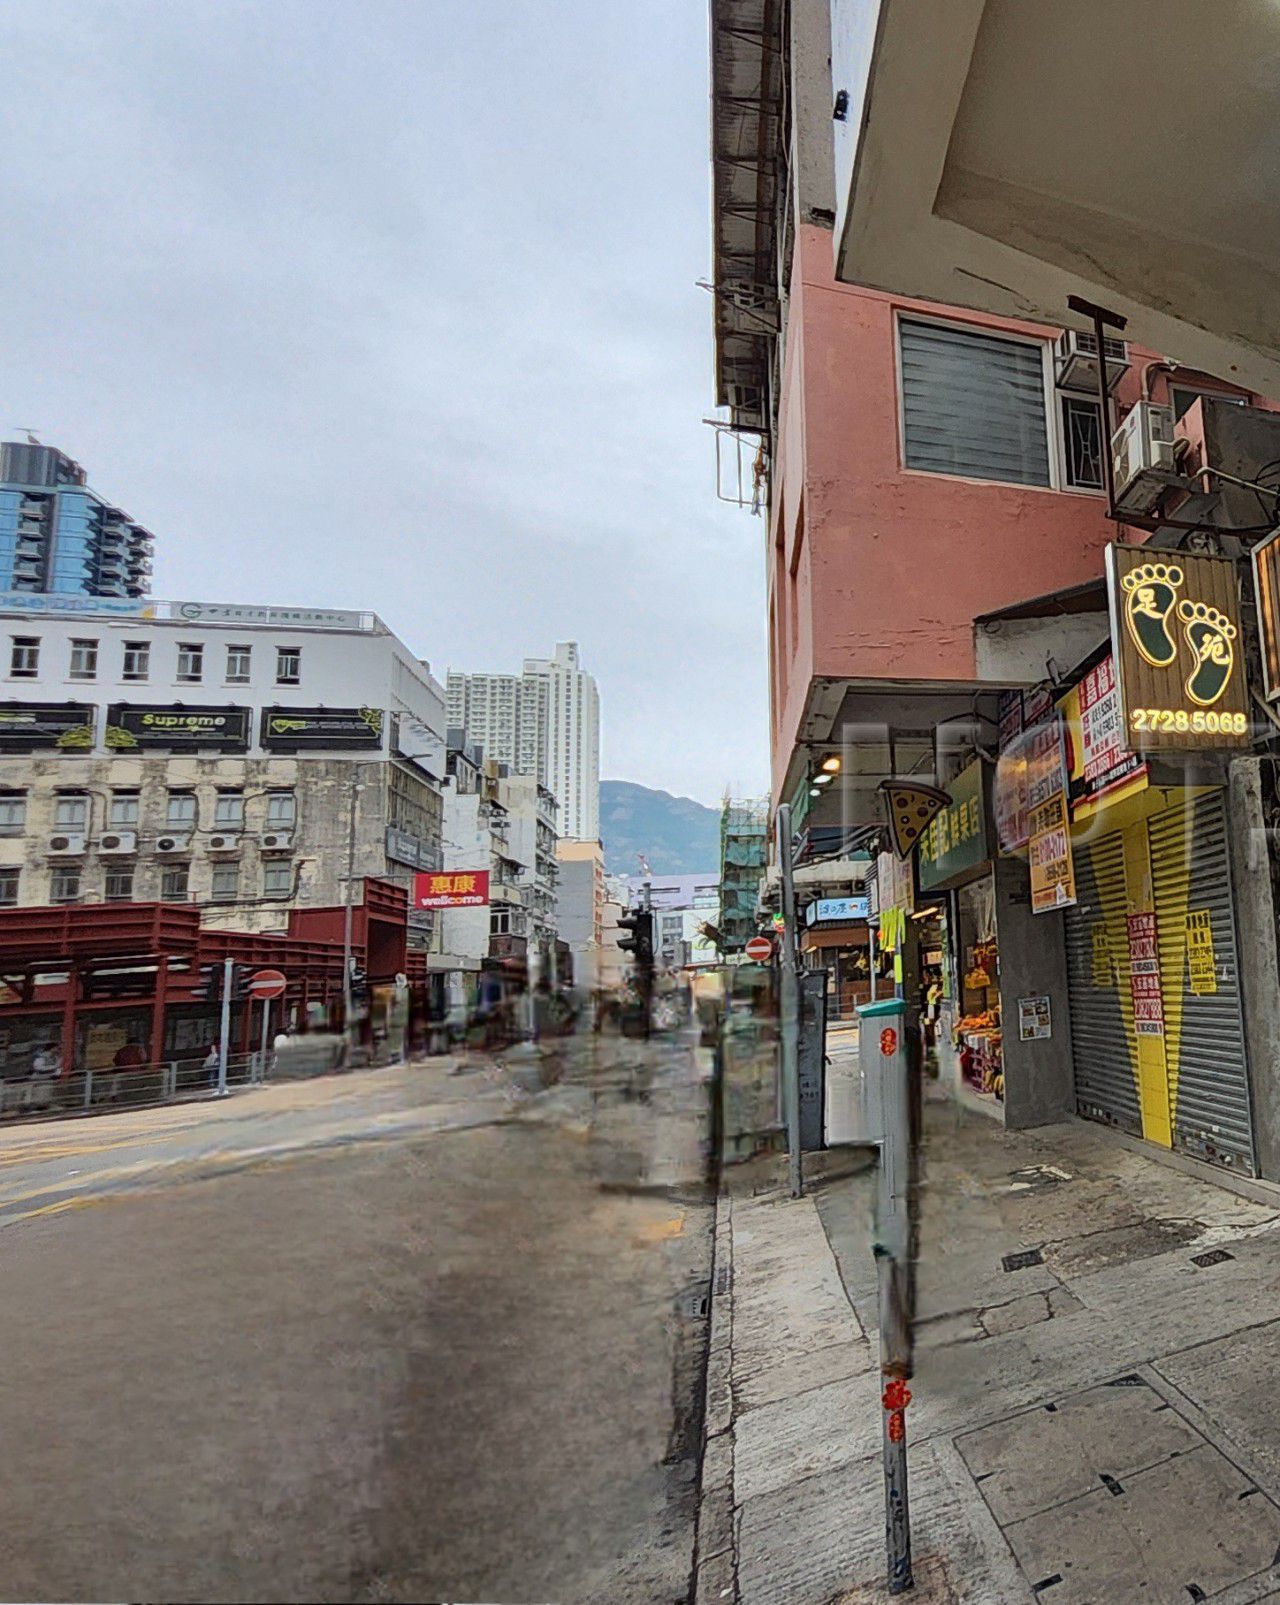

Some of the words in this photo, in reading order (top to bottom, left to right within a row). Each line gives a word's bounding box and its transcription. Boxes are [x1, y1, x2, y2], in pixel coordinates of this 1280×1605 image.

[1131, 588, 1164, 619] 足
[1199, 633, 1229, 665] 苑
[141, 713, 226, 728] Supreme
[1131, 709, 1190, 736] 2728
[1189, 711, 1249, 737] 5068
[429, 874, 476, 894] 惠康
[420, 895, 484, 907] wellcome
